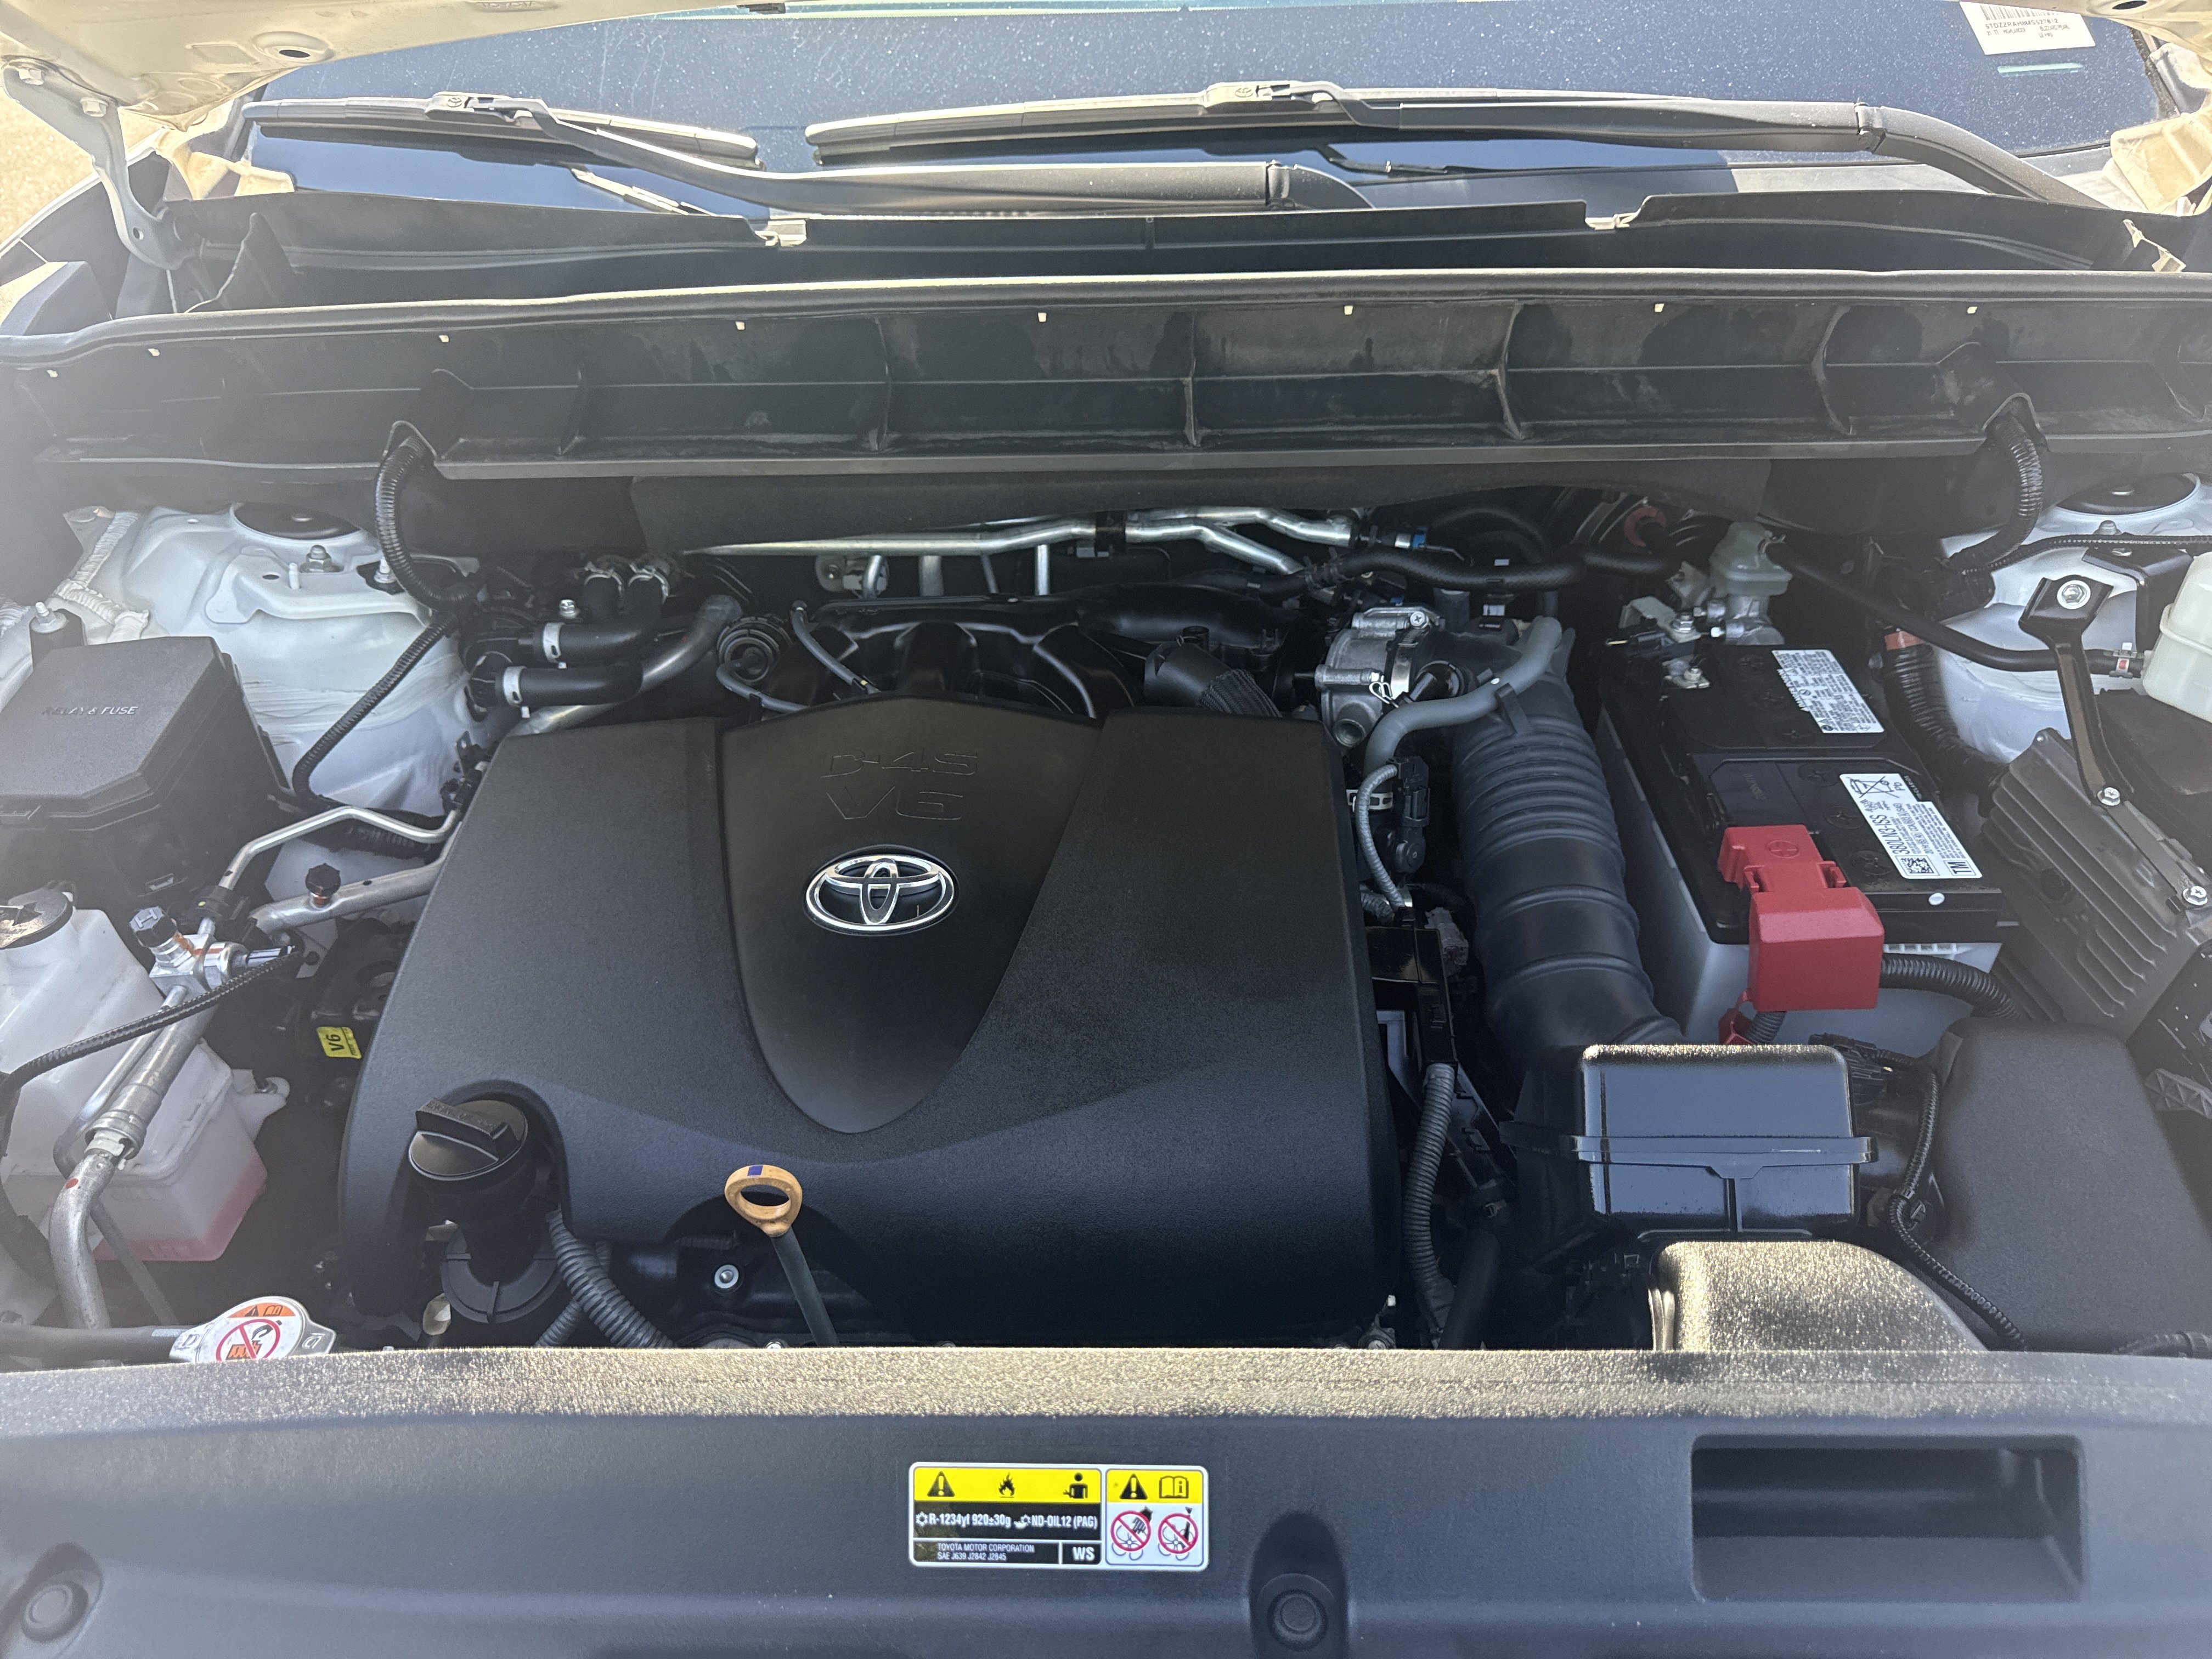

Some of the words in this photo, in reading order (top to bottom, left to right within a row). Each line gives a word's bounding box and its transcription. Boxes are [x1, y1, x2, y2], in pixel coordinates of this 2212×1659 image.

[88, 707, 98, 715] &
[101, 706, 138, 715] FUSE
[821, 748, 977, 778] D-4S
[1893, 782, 1905, 791] Pb
[825, 783, 964, 820] V6
[1869, 814, 1910, 854] 380LN3-ISS
[1948, 862, 1972, 874] TM
[134, 909, 157, 929] H
[326, 1034, 345, 1051] V6
[929, 1513, 970, 1528] R-1234yf
[972, 1513, 1011, 1528] 920±30g
[1031, 1515, 1071, 1528] ND-OIL12
[1073, 1516, 1098, 1529] (PAG)
[938, 1543, 962, 1551] TOYOTA
[964, 1544, 987, 1552] MOTOR
[989, 1544, 1035, 1553] CORPORATION
[1073, 1547, 1095, 1561] WS
[951, 1552, 966, 1560] J639
[967, 1553, 986, 1561] J2842
[988, 1553, 1007, 1561] J2845
